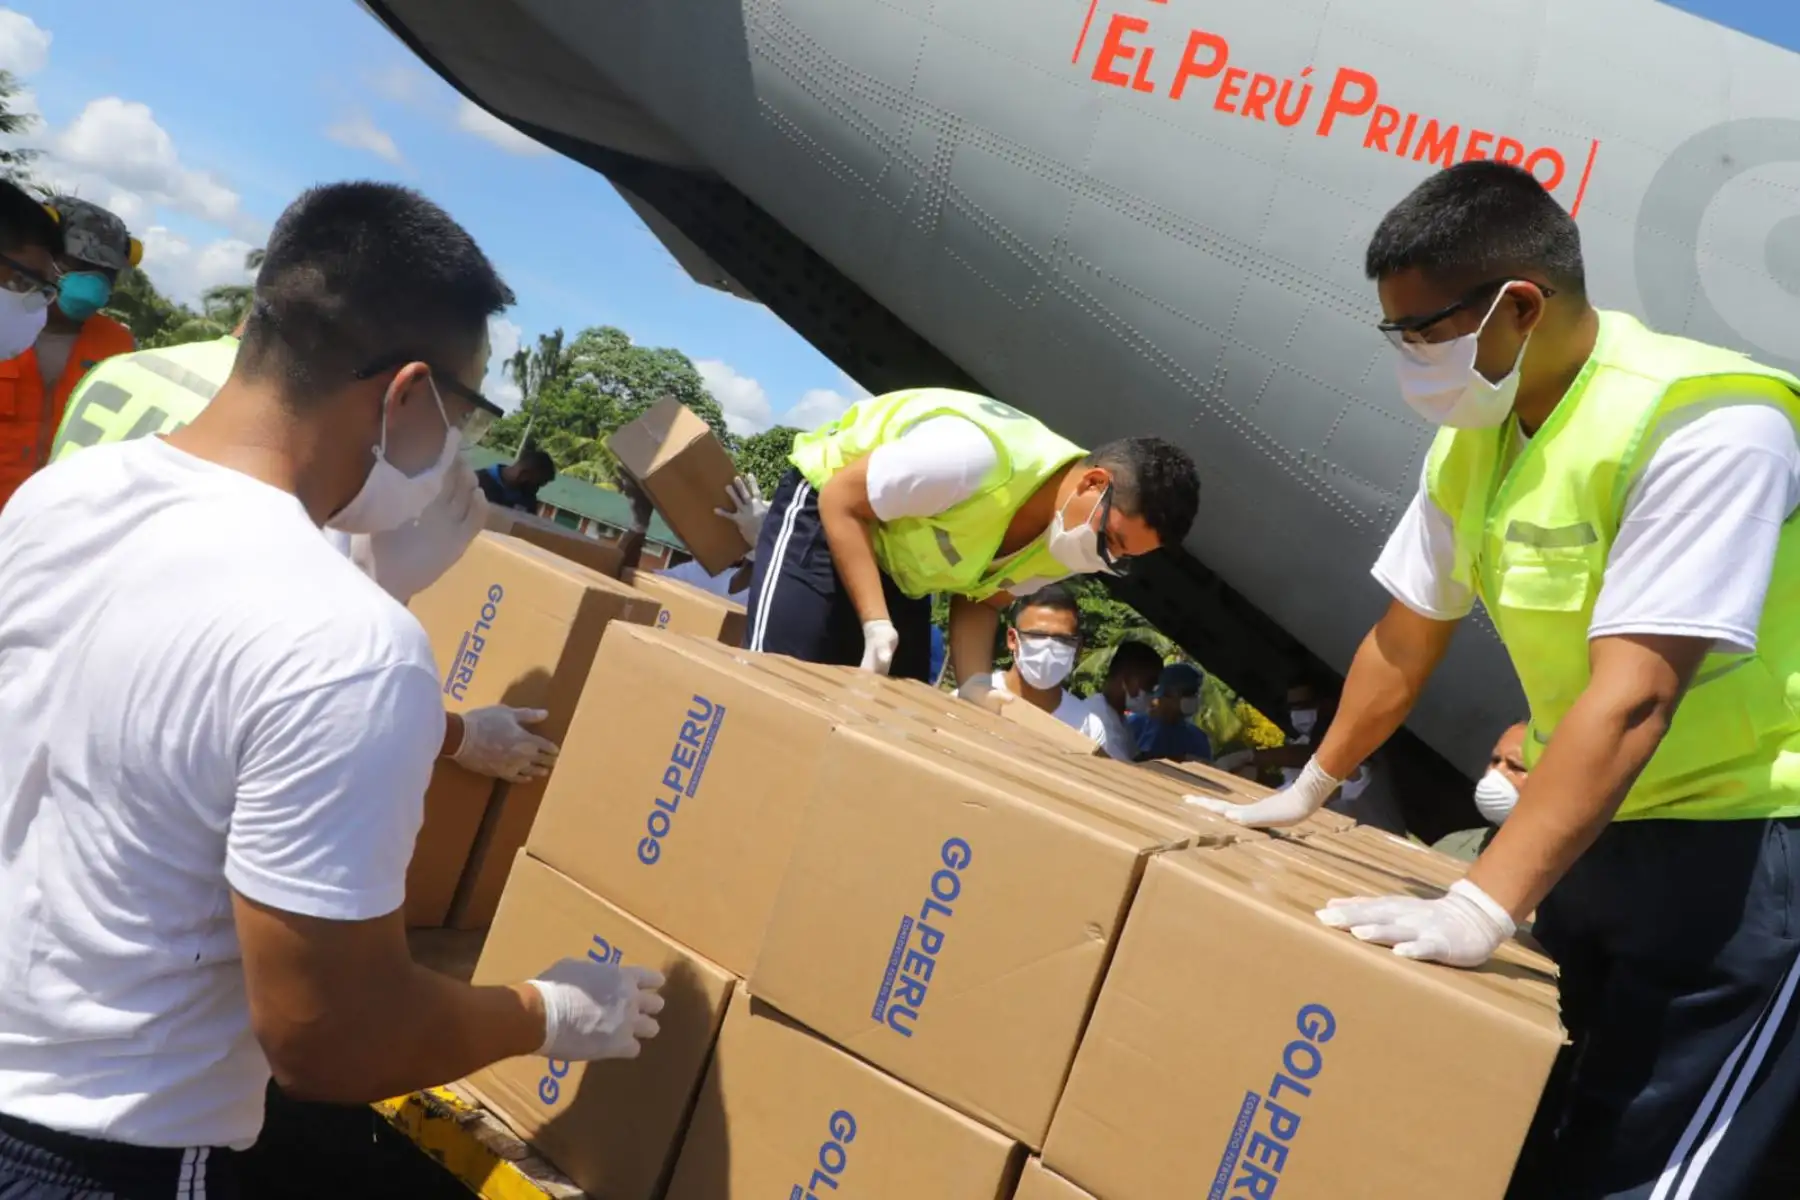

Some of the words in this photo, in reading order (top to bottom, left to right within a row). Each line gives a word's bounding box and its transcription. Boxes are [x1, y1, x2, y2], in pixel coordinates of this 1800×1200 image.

[1091, 13, 1155, 93] EL
[1169, 29, 1313, 127] PERÚ
[450, 583, 504, 702] GOLPERU
[637, 693, 714, 865] GOLPERU
[886, 837, 972, 1038] GOLPERU
[804, 1109, 857, 1200] GOL
[1231, 1003, 1337, 1200] GOLPER
